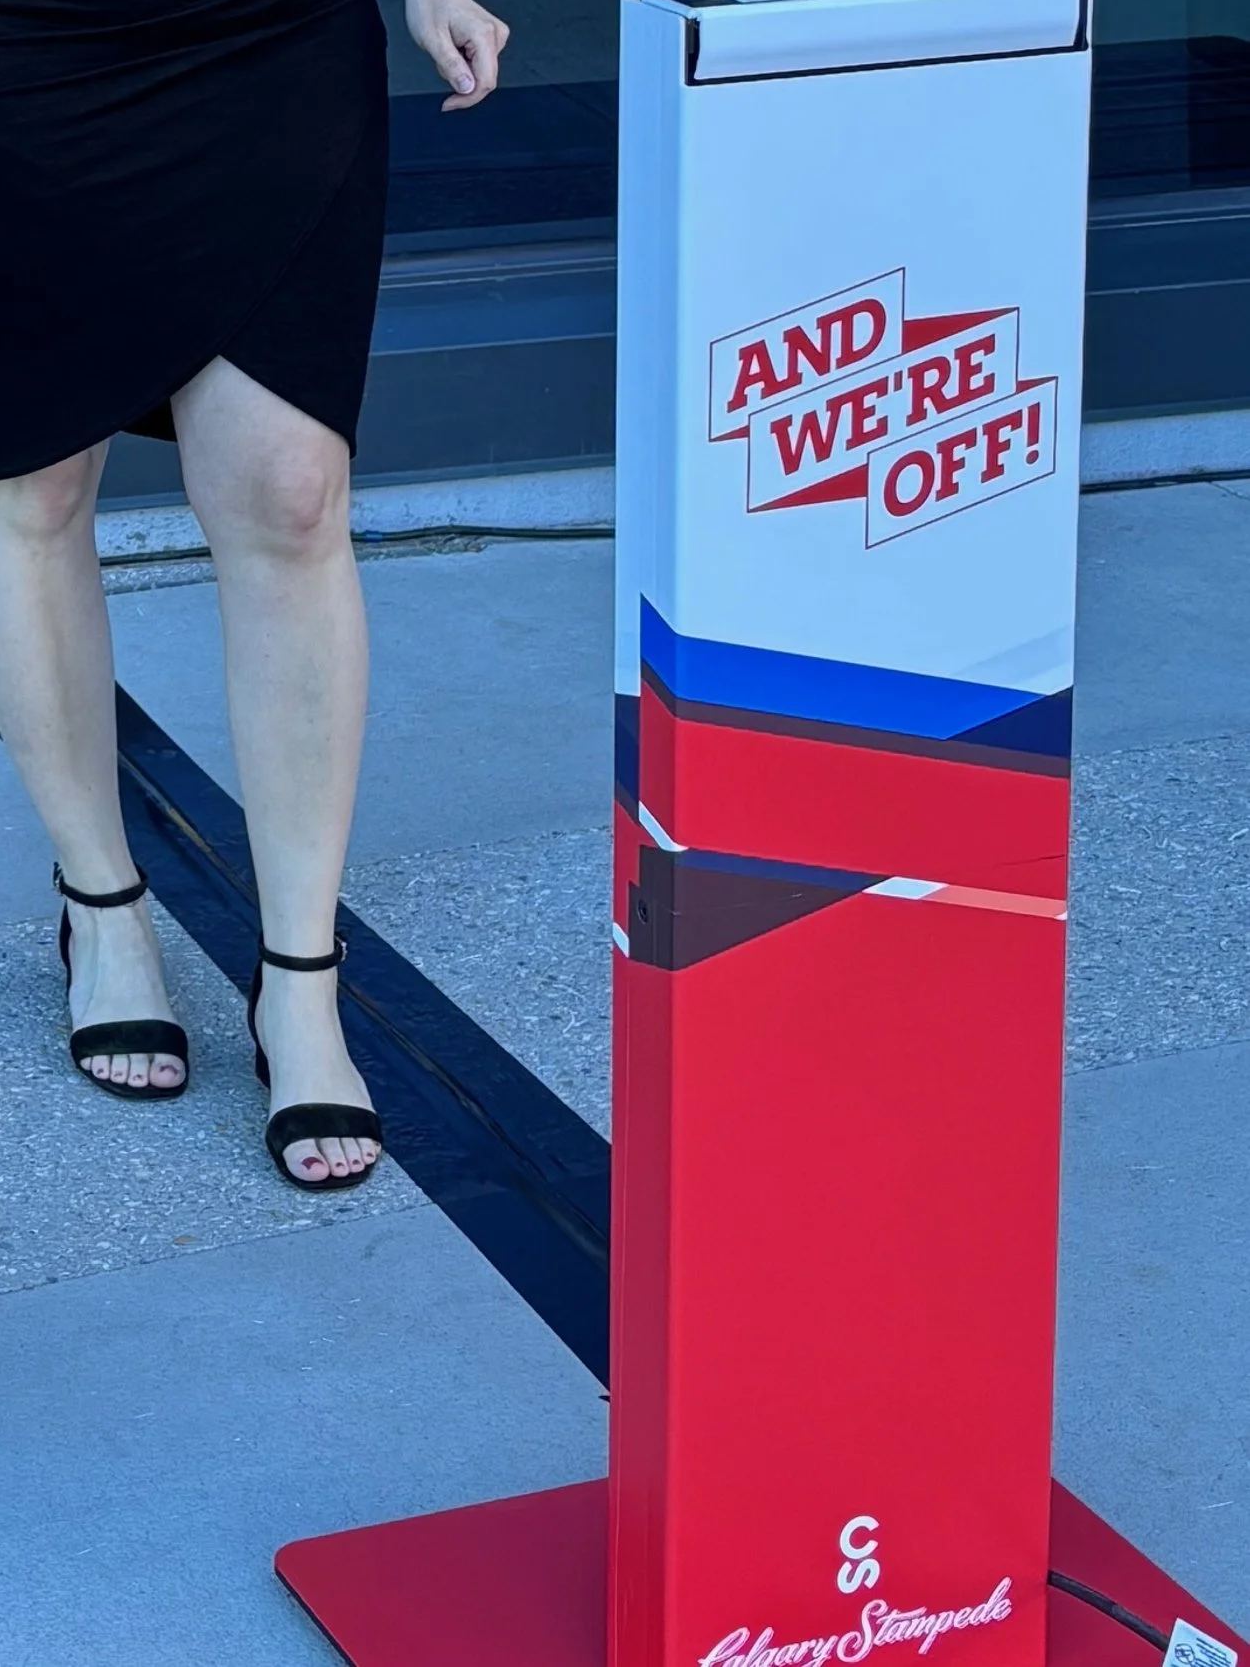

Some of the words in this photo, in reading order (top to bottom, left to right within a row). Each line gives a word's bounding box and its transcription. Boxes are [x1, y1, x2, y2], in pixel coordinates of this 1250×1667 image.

[726, 298, 887, 414] AND
[770, 333, 996, 476] WE'RE
[882, 401, 1041, 518] OFF!
[836, 1576, 1013, 1663] Stampede
